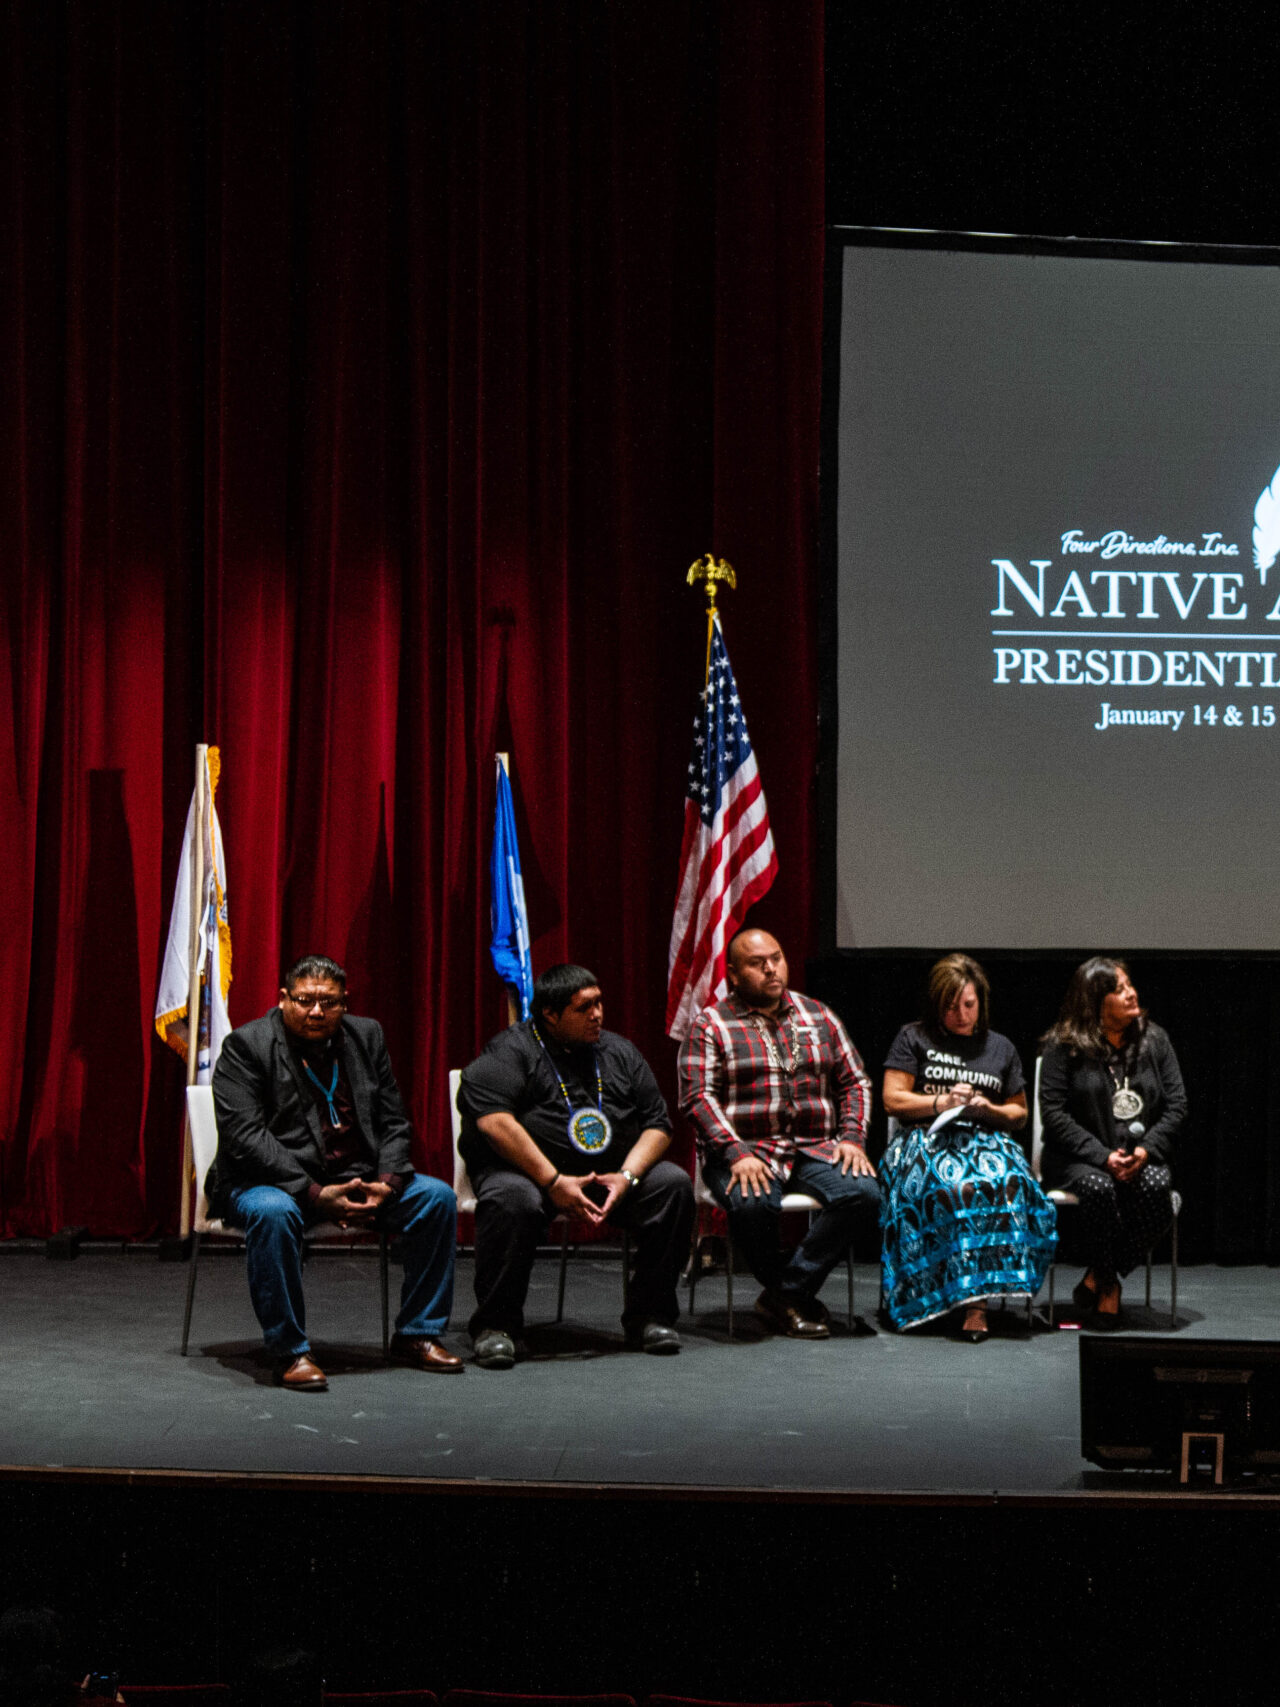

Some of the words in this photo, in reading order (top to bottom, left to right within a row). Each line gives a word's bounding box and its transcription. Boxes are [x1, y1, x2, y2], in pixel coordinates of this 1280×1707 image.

[1061, 529, 1100, 555] Four
[1095, 703, 1186, 731] January
[1194, 704, 1219, 726] 14
[1223, 705, 1244, 727] &
[1252, 705, 1277, 727] 15
[926, 1049, 967, 1067] CARE.
